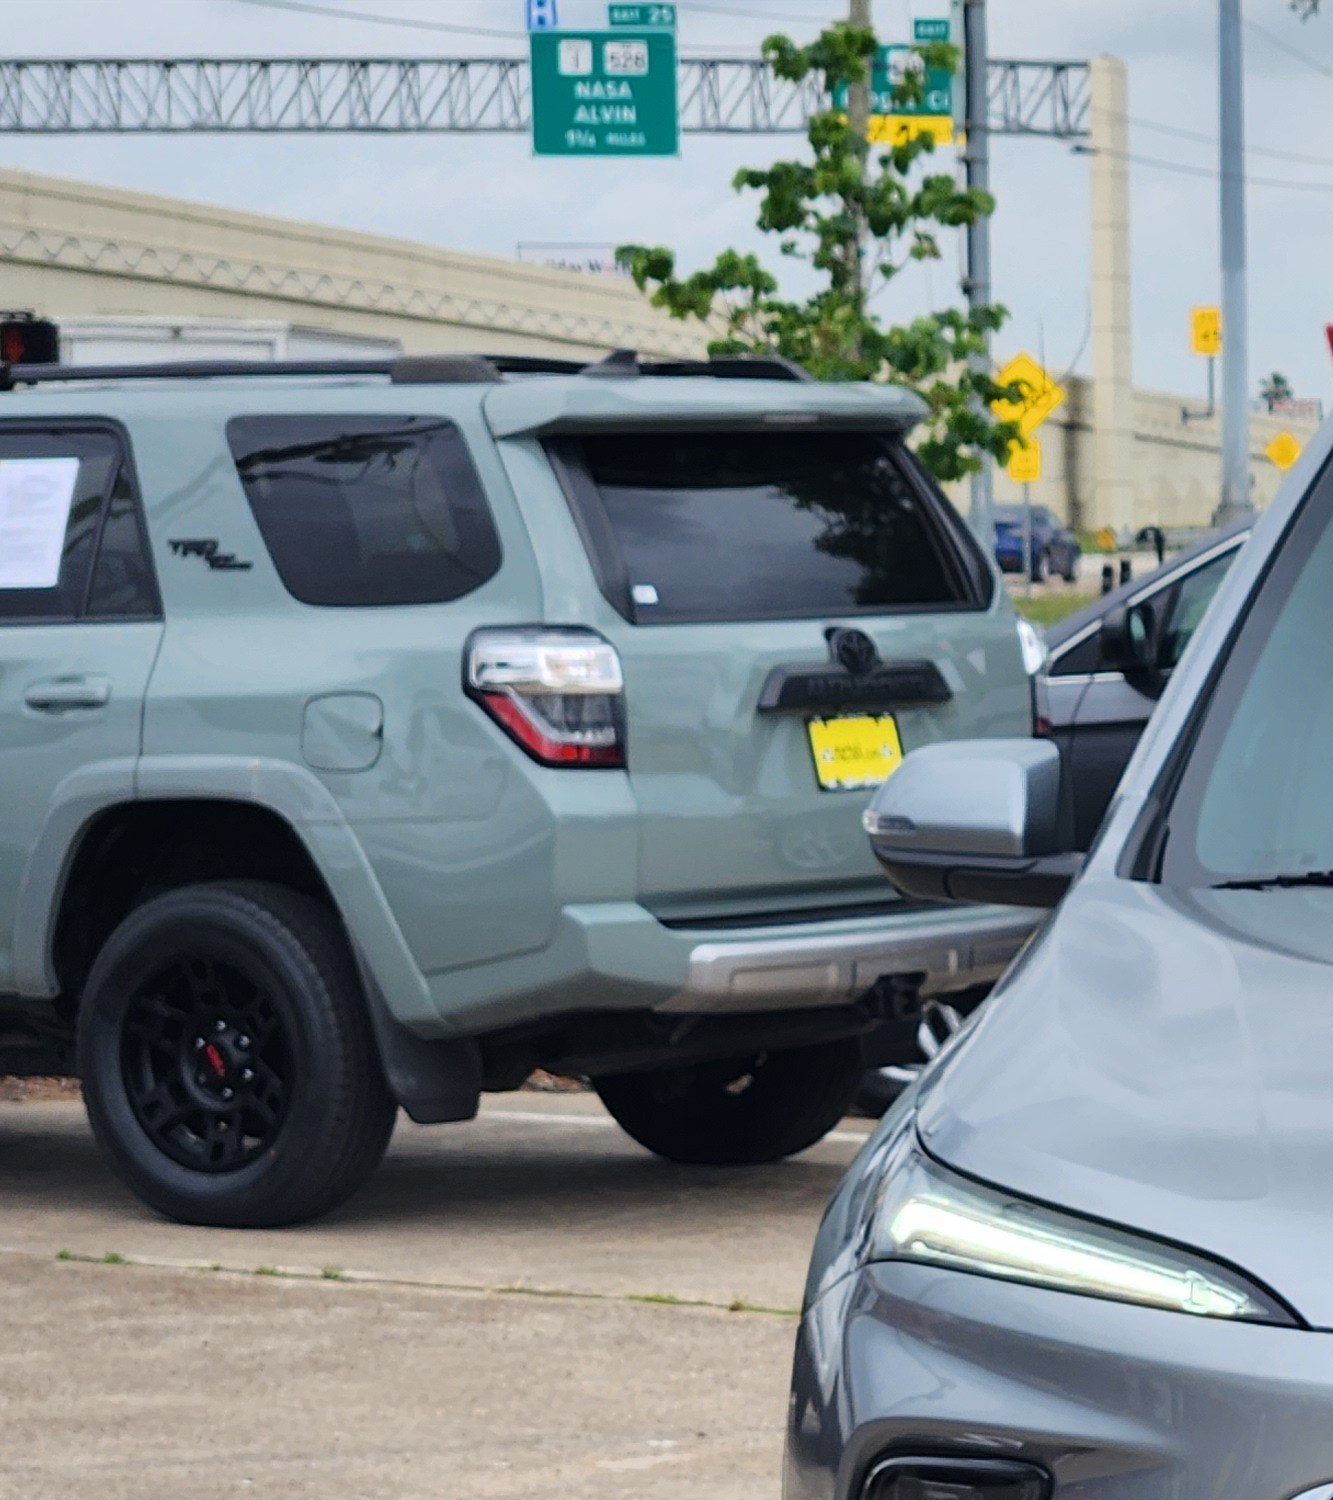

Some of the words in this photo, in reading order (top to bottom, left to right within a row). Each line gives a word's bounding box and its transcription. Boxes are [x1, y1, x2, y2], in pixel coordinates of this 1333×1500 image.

[649, 6, 673, 24] 25
[609, 51, 646, 70] 528
[575, 81, 632, 98] NASA
[574, 105, 636, 124] ALVIN
